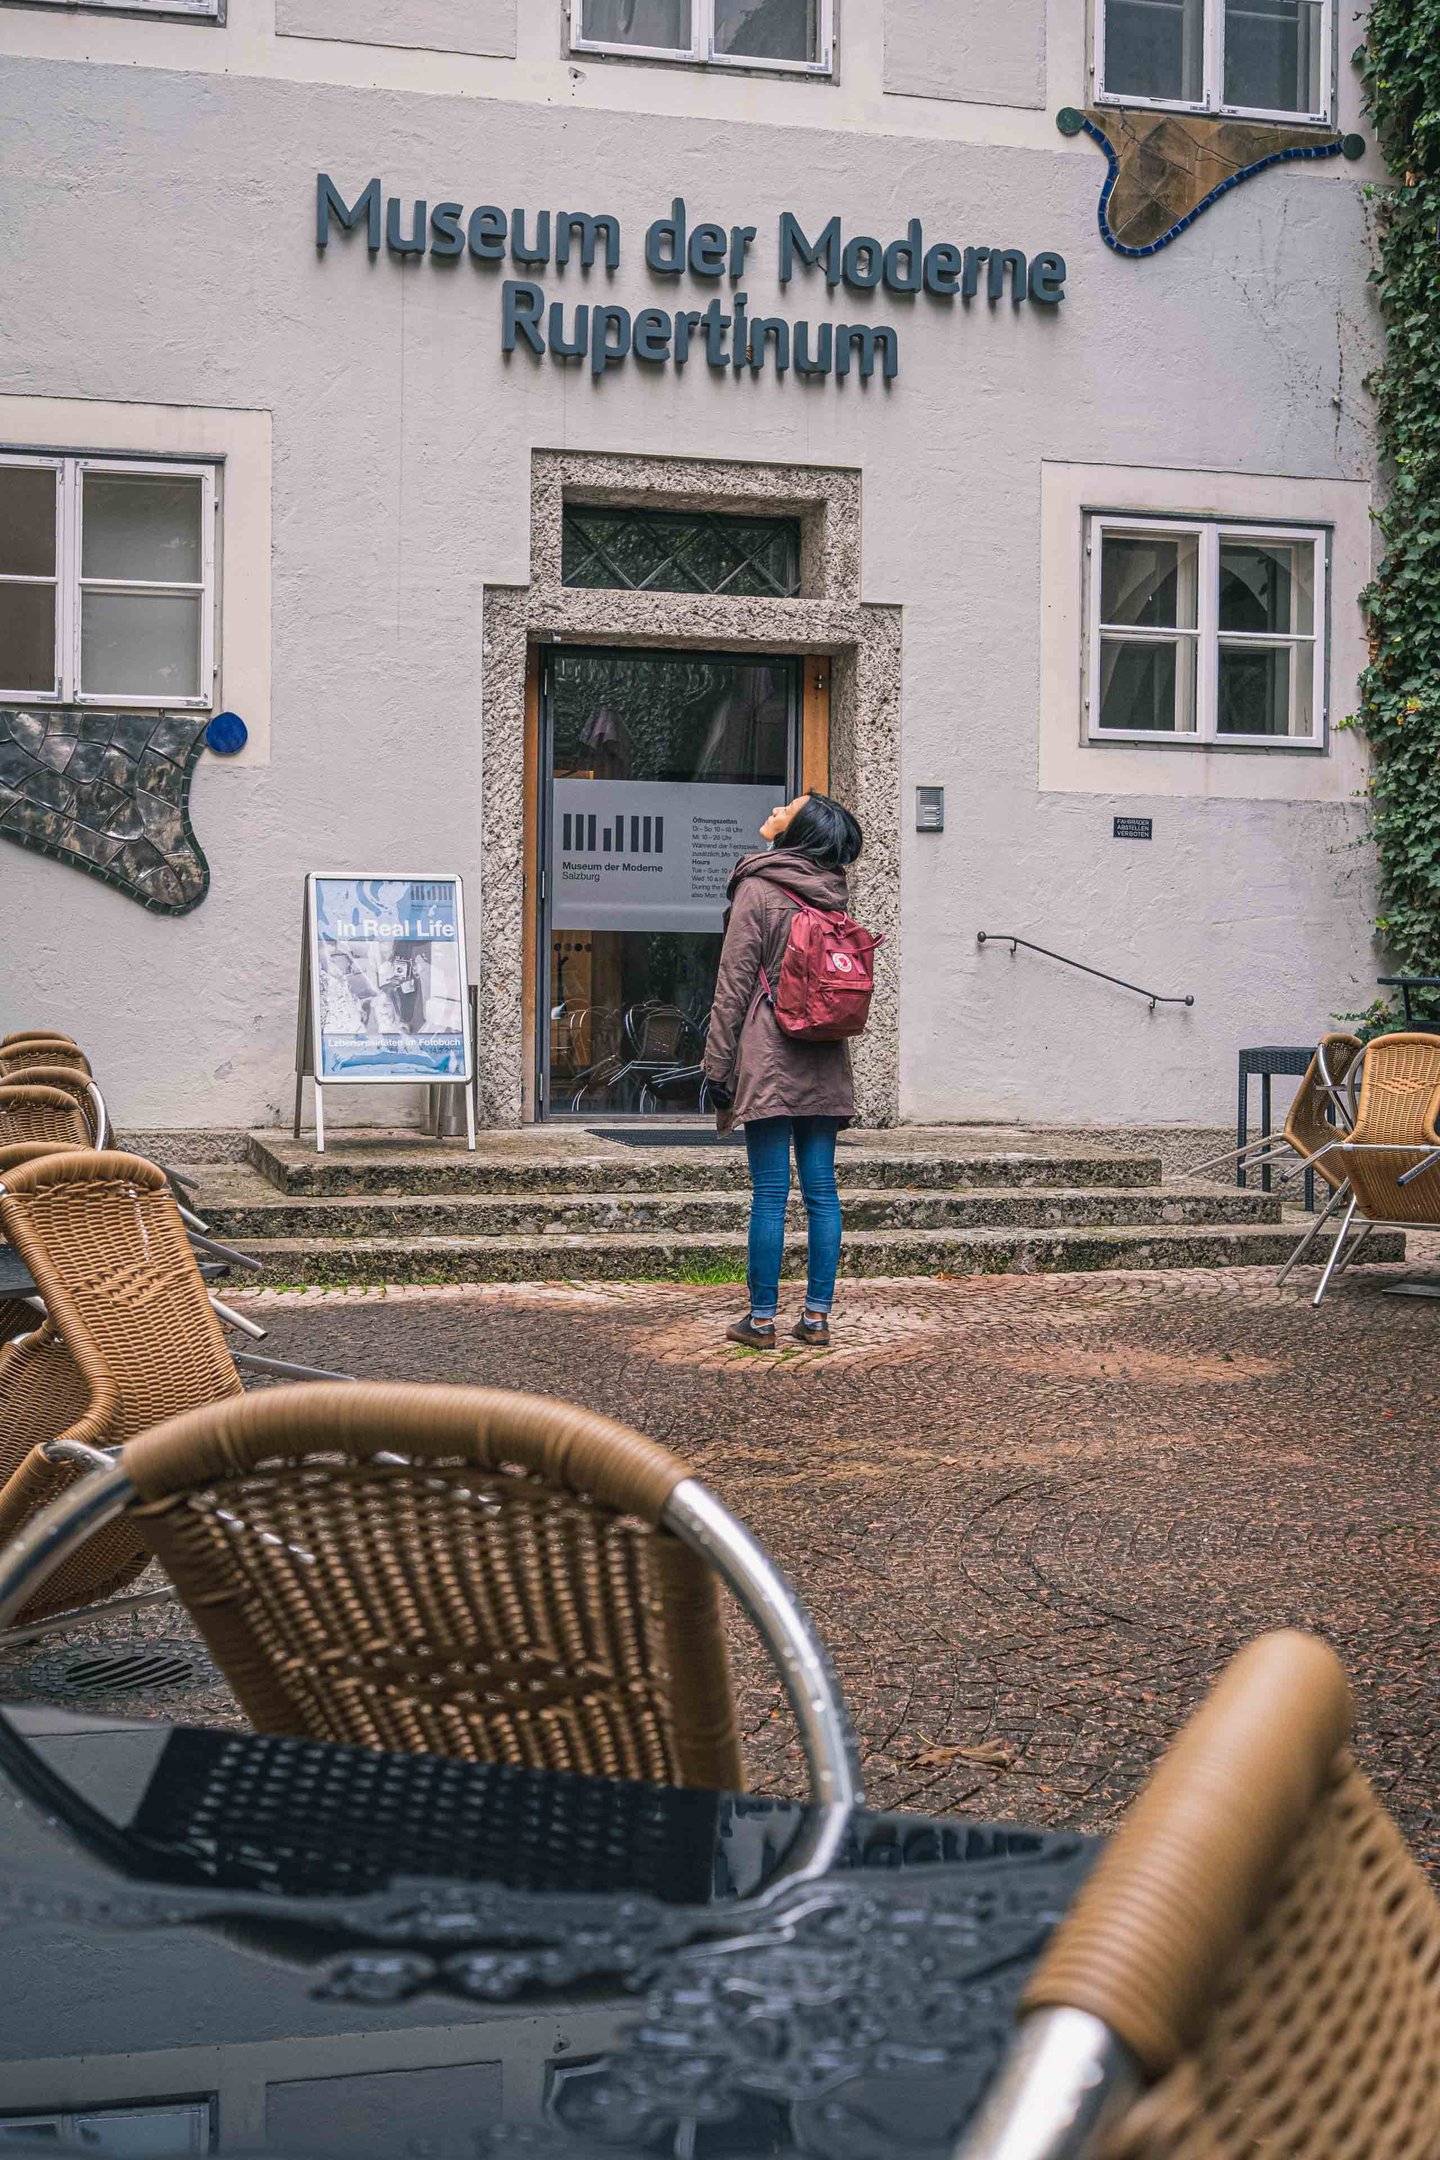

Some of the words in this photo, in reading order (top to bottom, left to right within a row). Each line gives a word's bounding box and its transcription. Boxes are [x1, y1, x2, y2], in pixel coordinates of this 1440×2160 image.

[316, 173, 620, 270] Museum
[644, 197, 757, 277] der
[779, 211, 1067, 305] Moderne
[501, 280, 899, 380] Rupertinum
[562, 861, 602, 871] Museum
[604, 863, 620, 872] der
[622, 863, 663, 873] Moderne
[562, 872, 600, 881] Salzburg
[337, 919, 356, 936] In
[364, 919, 409, 936] Real
[416, 919, 455, 937] Life
[419, 1037, 461, 1047] Fotobuch
